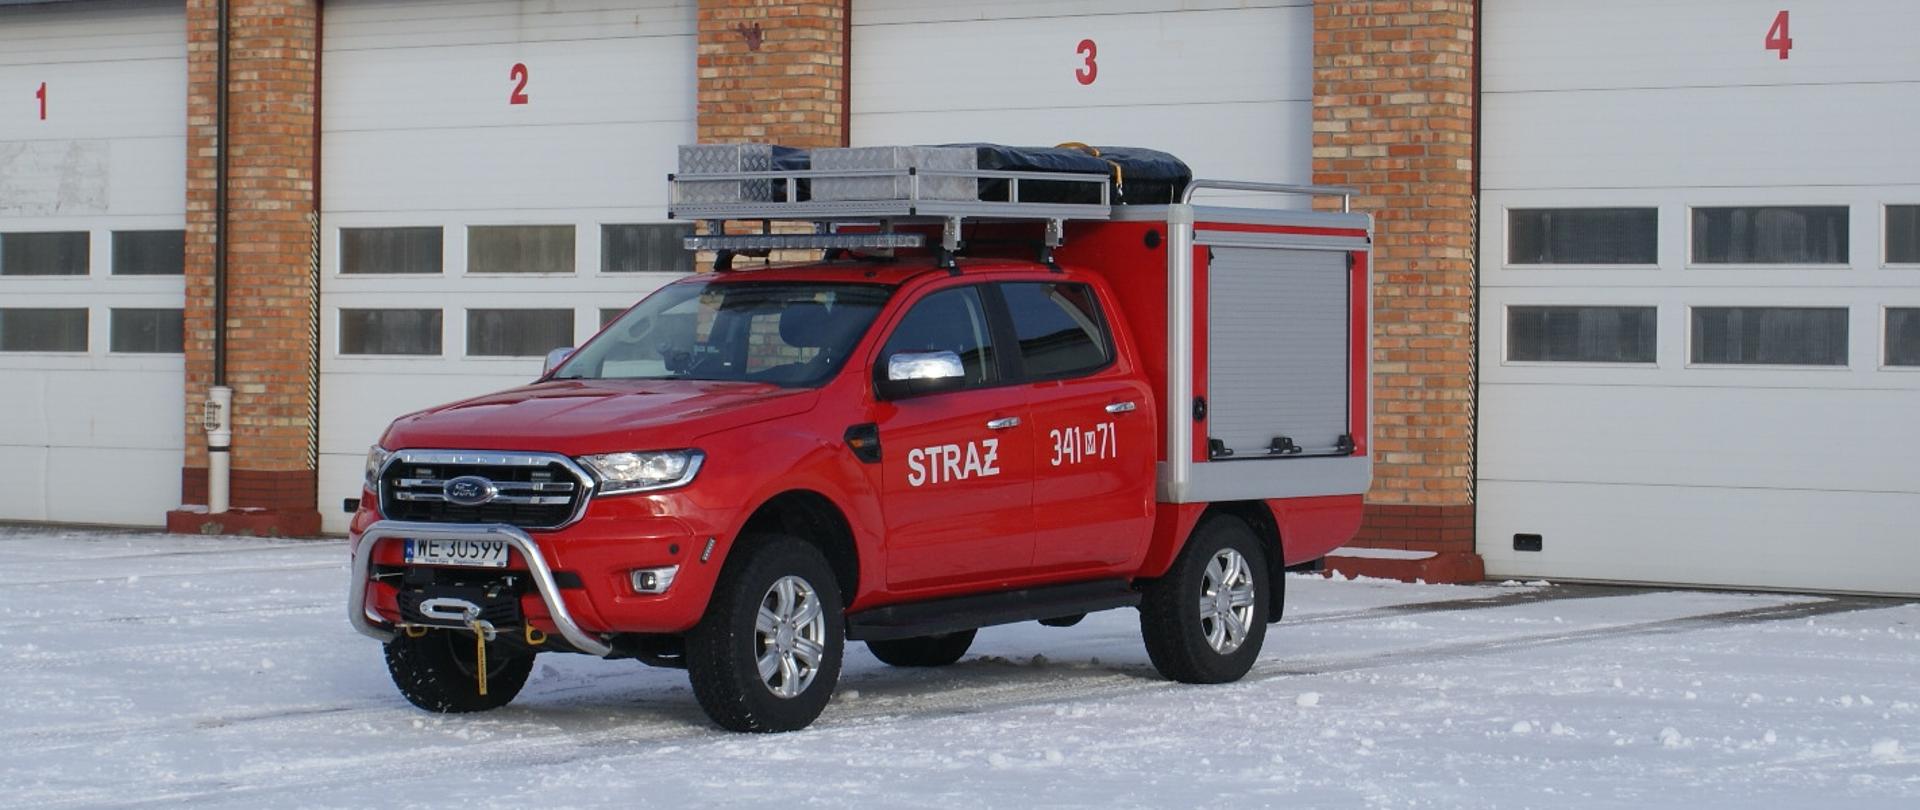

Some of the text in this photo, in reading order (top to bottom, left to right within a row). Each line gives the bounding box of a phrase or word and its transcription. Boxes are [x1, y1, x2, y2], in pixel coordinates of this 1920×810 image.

[1764, 10, 1792, 60] 4
[1075, 39, 1098, 86] 3
[36, 82, 47, 120] 1
[509, 63, 529, 105] 2
[907, 438, 1000, 487] STRAŻ
[452, 482, 477, 497] Ford
[418, 539, 440, 557] WE
[446, 539, 504, 560] 30599
